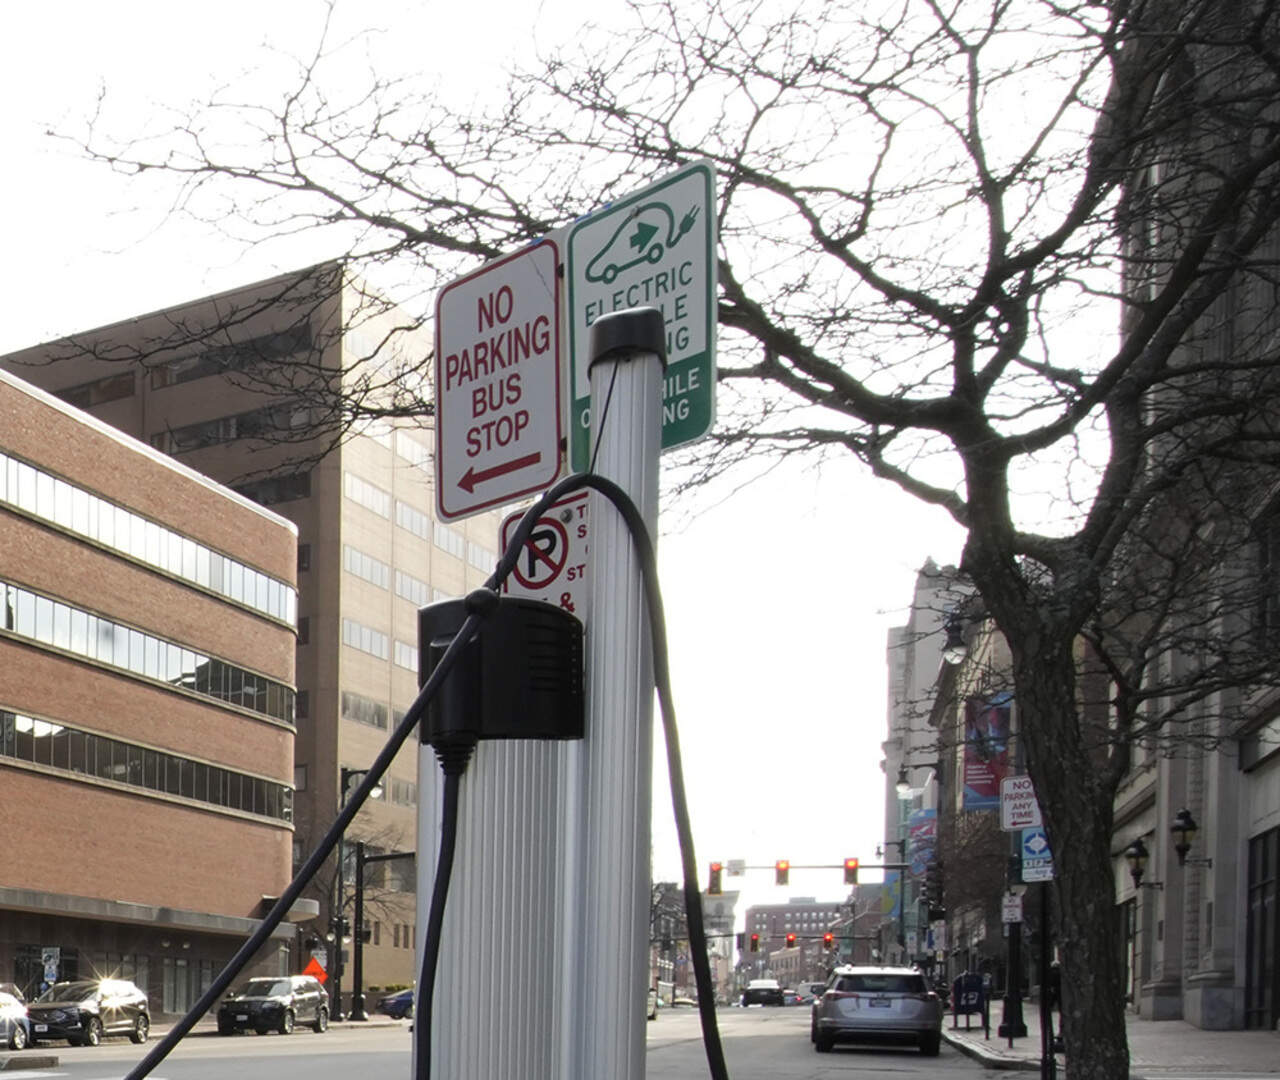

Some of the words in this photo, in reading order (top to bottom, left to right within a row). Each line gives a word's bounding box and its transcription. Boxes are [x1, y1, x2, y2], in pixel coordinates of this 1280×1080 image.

[477, 285, 513, 333] NO
[445, 315, 550, 392] PARKING
[471, 373, 522, 418] BUS
[466, 410, 530, 457] STOP
[1004, 792, 1035, 802] PARKIN
[1013, 780, 1031, 790] NO
[1011, 810, 1034, 819] TIME
[1012, 801, 1032, 810] ANY
